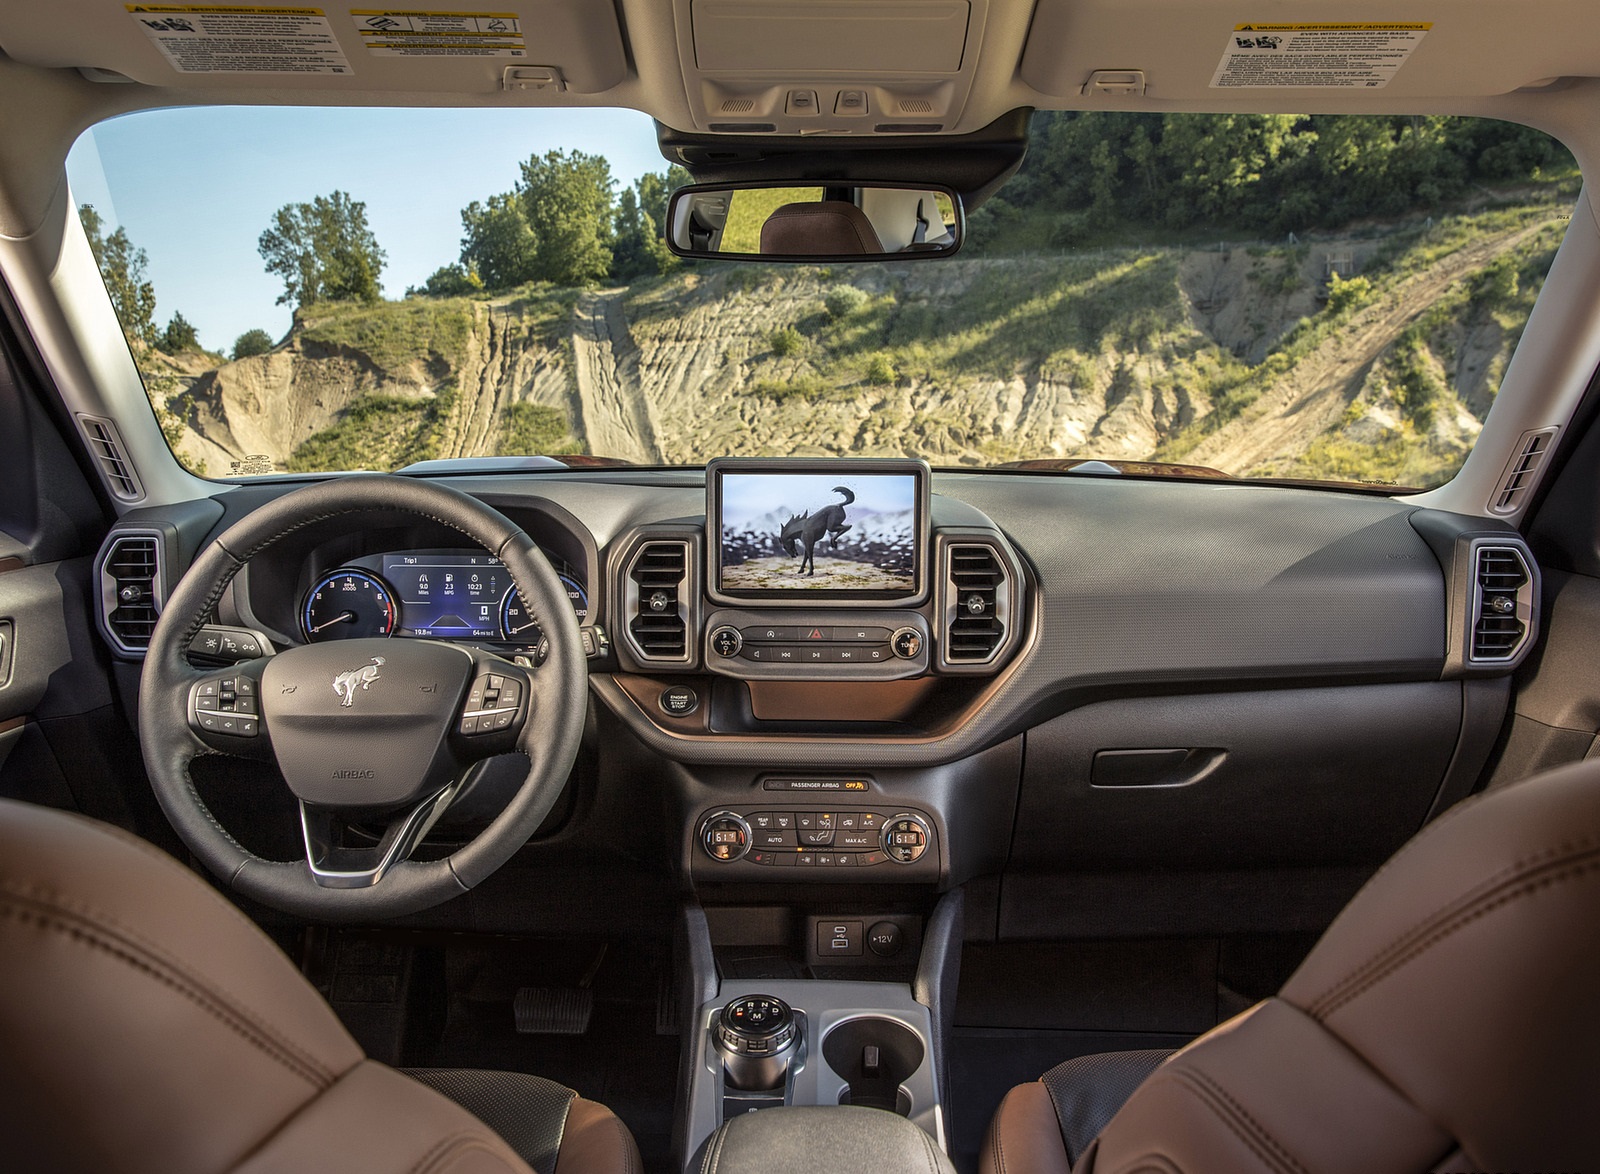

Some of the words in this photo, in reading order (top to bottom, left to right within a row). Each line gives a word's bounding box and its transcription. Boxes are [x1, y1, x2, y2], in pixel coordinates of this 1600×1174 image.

[332, 770, 374, 779] AIRBAG
[716, 833, 727, 842] 61
[896, 835, 907, 843] 61
